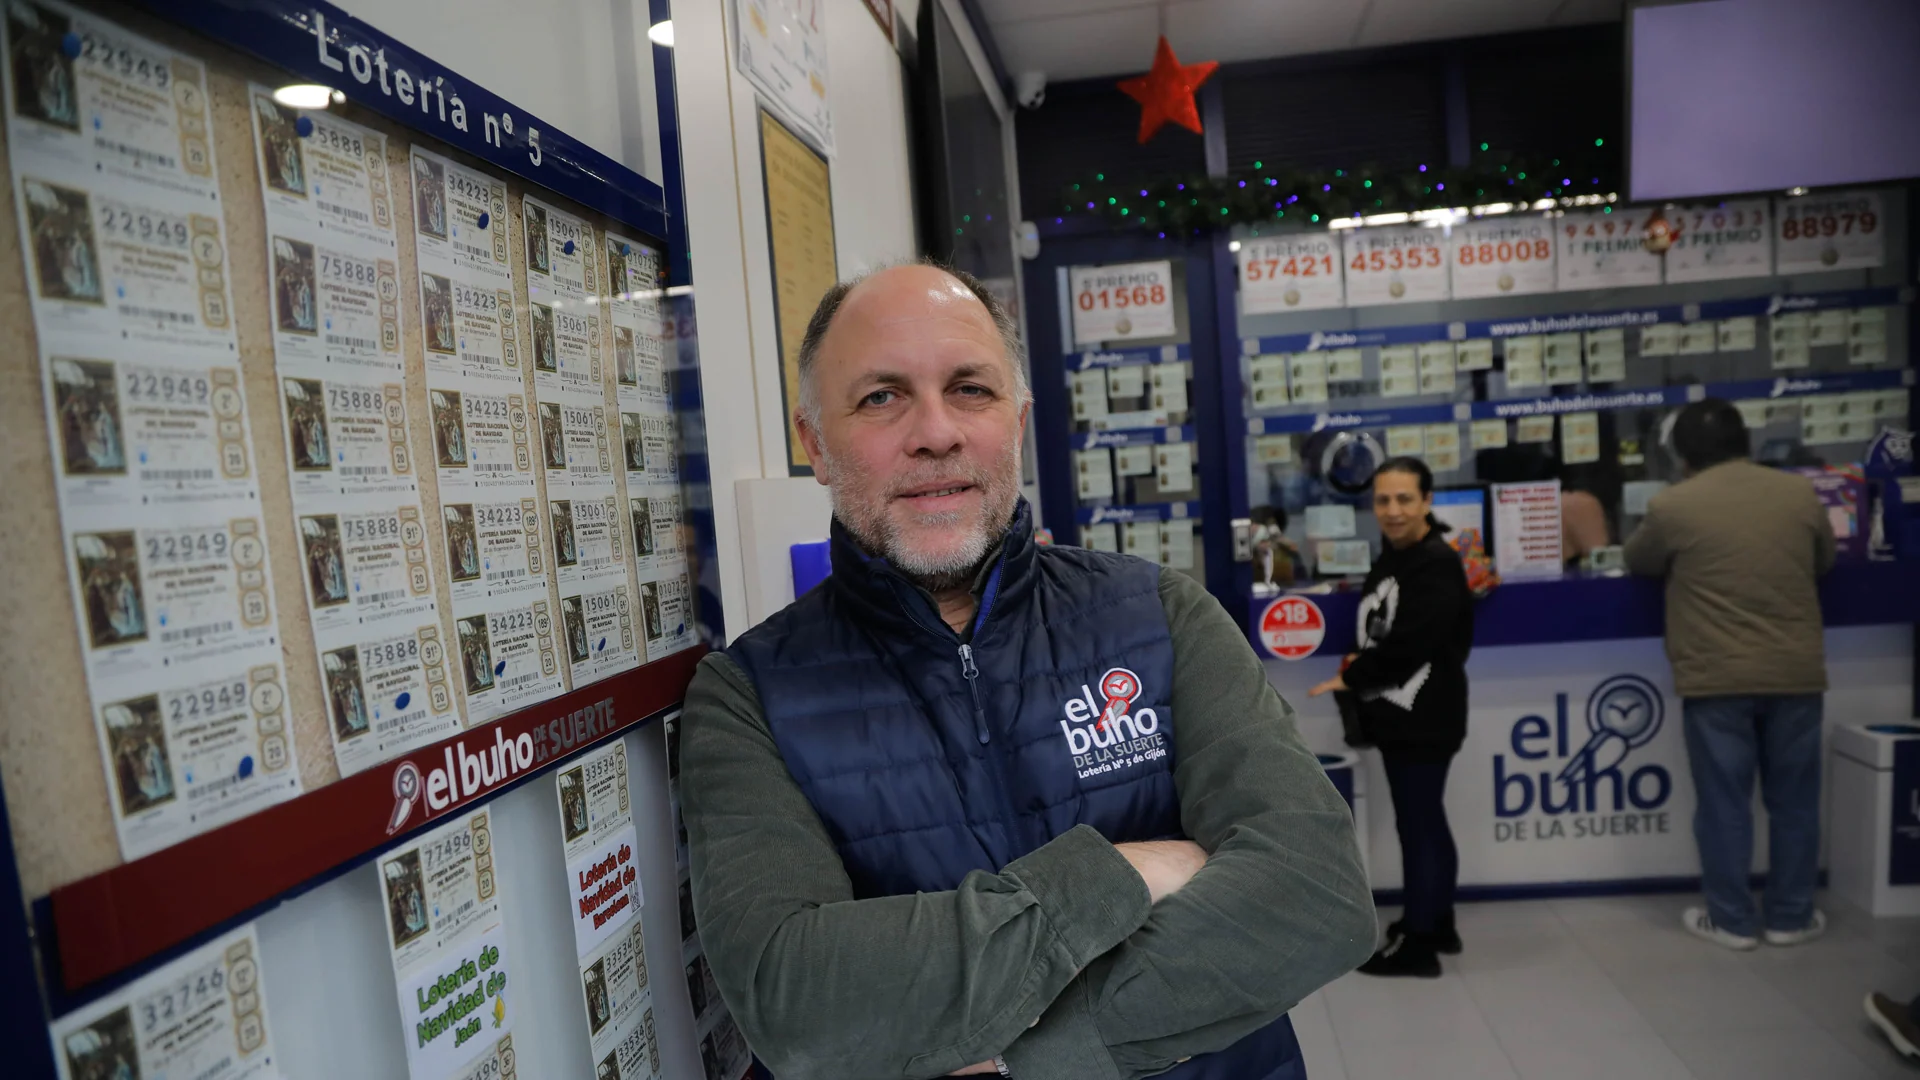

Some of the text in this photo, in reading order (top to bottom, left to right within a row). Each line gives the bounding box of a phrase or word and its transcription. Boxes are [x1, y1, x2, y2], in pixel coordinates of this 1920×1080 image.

[316, 13, 468, 132] Lotería
[529, 126, 542, 167] 5
[309, 126, 362, 157] 5888
[448, 175, 489, 203] 34223
[102, 207, 188, 245] 22949
[550, 218, 580, 242] 15061
[1782, 212, 1876, 240] 88979
[1266, 242, 1329, 256] PREMIO
[1351, 247, 1441, 273] 45353
[1459, 239, 1549, 266] 88008
[320, 256, 375, 283] 75888
[1097, 272, 1159, 287] PREMIO
[1247, 254, 1333, 281] 57421
[455, 288, 496, 310] 34223
[1079, 284, 1165, 311] 01568
[557, 314, 587, 334] 15061
[1489, 311, 1659, 336] www.buhodelasuerte.es
[635, 334, 658, 350] 01072
[128, 373, 208, 400] 22949
[329, 390, 383, 409] 75888
[466, 399, 508, 416] 34223
[1495, 392, 1663, 416] www.buhodelasuerte.es
[564, 411, 594, 425] 15061
[642, 419, 664, 431] 01072
[478, 507, 520, 524] 34223
[575, 504, 606, 518] 15061
[651, 501, 672, 513] 01072
[344, 518, 398, 537] 75888
[480, 530, 499, 538] LOTERÍA
[145, 533, 227, 560] 22949
[659, 581, 680, 596] 01072
[586, 594, 616, 611] 15061
[1272, 603, 1309, 624] +18
[492, 612, 533, 634] 34223
[363, 640, 418, 666] 75888
[492, 633, 534, 648] LOTERÍA NACIONAL
[508, 642, 528, 652] NAVIDAD
[386, 675, 411, 687] NAVIDAD
[391, 664, 420, 676] NACIONAL
[170, 682, 246, 721] 22949
[1065, 684, 1100, 723] el
[533, 724, 547, 744] DE
[549, 697, 616, 756] SUERTE
[1060, 707, 1158, 754] buho
[1511, 692, 1569, 761] el
[535, 745, 549, 763] LA
[1073, 733, 1164, 768] DE LA SUERTE
[1078, 762, 1112, 779] Lotería
[1126, 758, 1132, 768] 5
[1133, 753, 1144, 763] de
[1144, 747, 1166, 761] Gijón
[586, 756, 615, 782] 33534
[1493, 748, 1673, 817] buho
[1494, 812, 1670, 843] DE LA SUERTE
[424, 830, 470, 868] 77496
[579, 844, 630, 892] Lotería de
[579, 865, 635, 919] Navidad de
[606, 937, 632, 971] 33534
[417, 945, 499, 1014] Lotería de
[145, 968, 223, 1032] 32746
[417, 971, 506, 1049] Navidad de
[455, 1017, 482, 1048] Jaén
[618, 1024, 645, 1063] 33534
